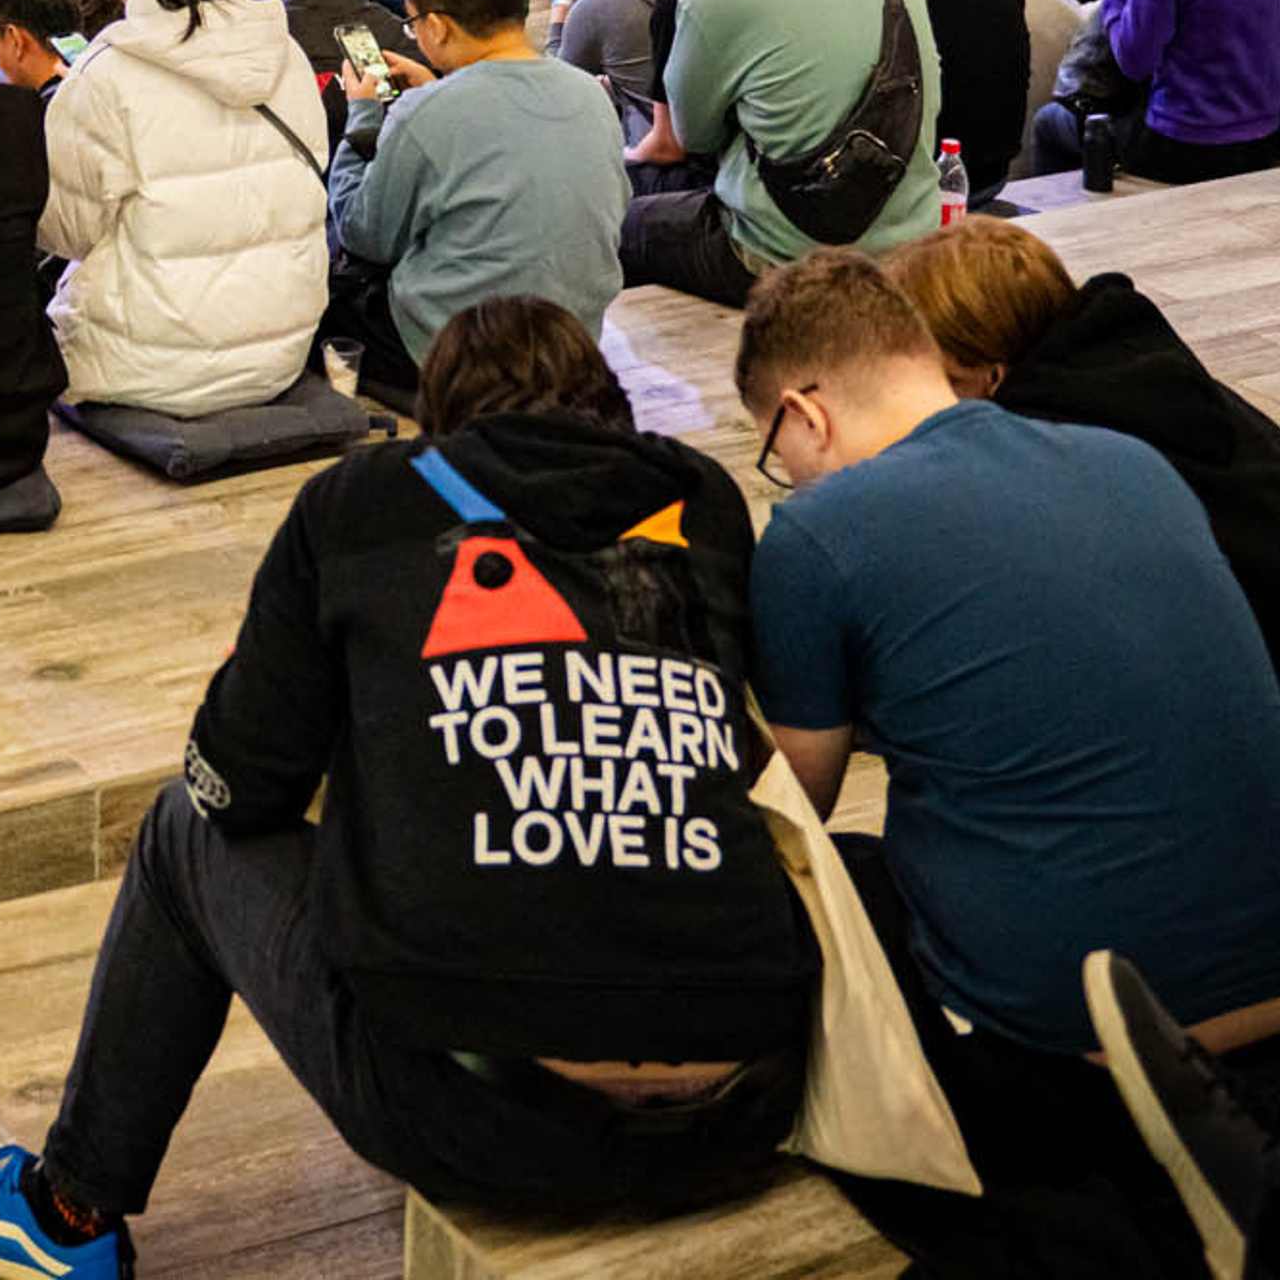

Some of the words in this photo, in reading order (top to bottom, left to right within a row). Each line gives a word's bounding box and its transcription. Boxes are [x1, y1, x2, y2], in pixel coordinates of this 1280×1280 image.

[430, 652, 548, 711] WE
[564, 650, 726, 719] NEED
[429, 705, 522, 765] TO
[539, 702, 740, 771] LEARN
[494, 755, 697, 816] WHAT
[473, 810, 651, 867] LOVE
[664, 816, 722, 871] IS
